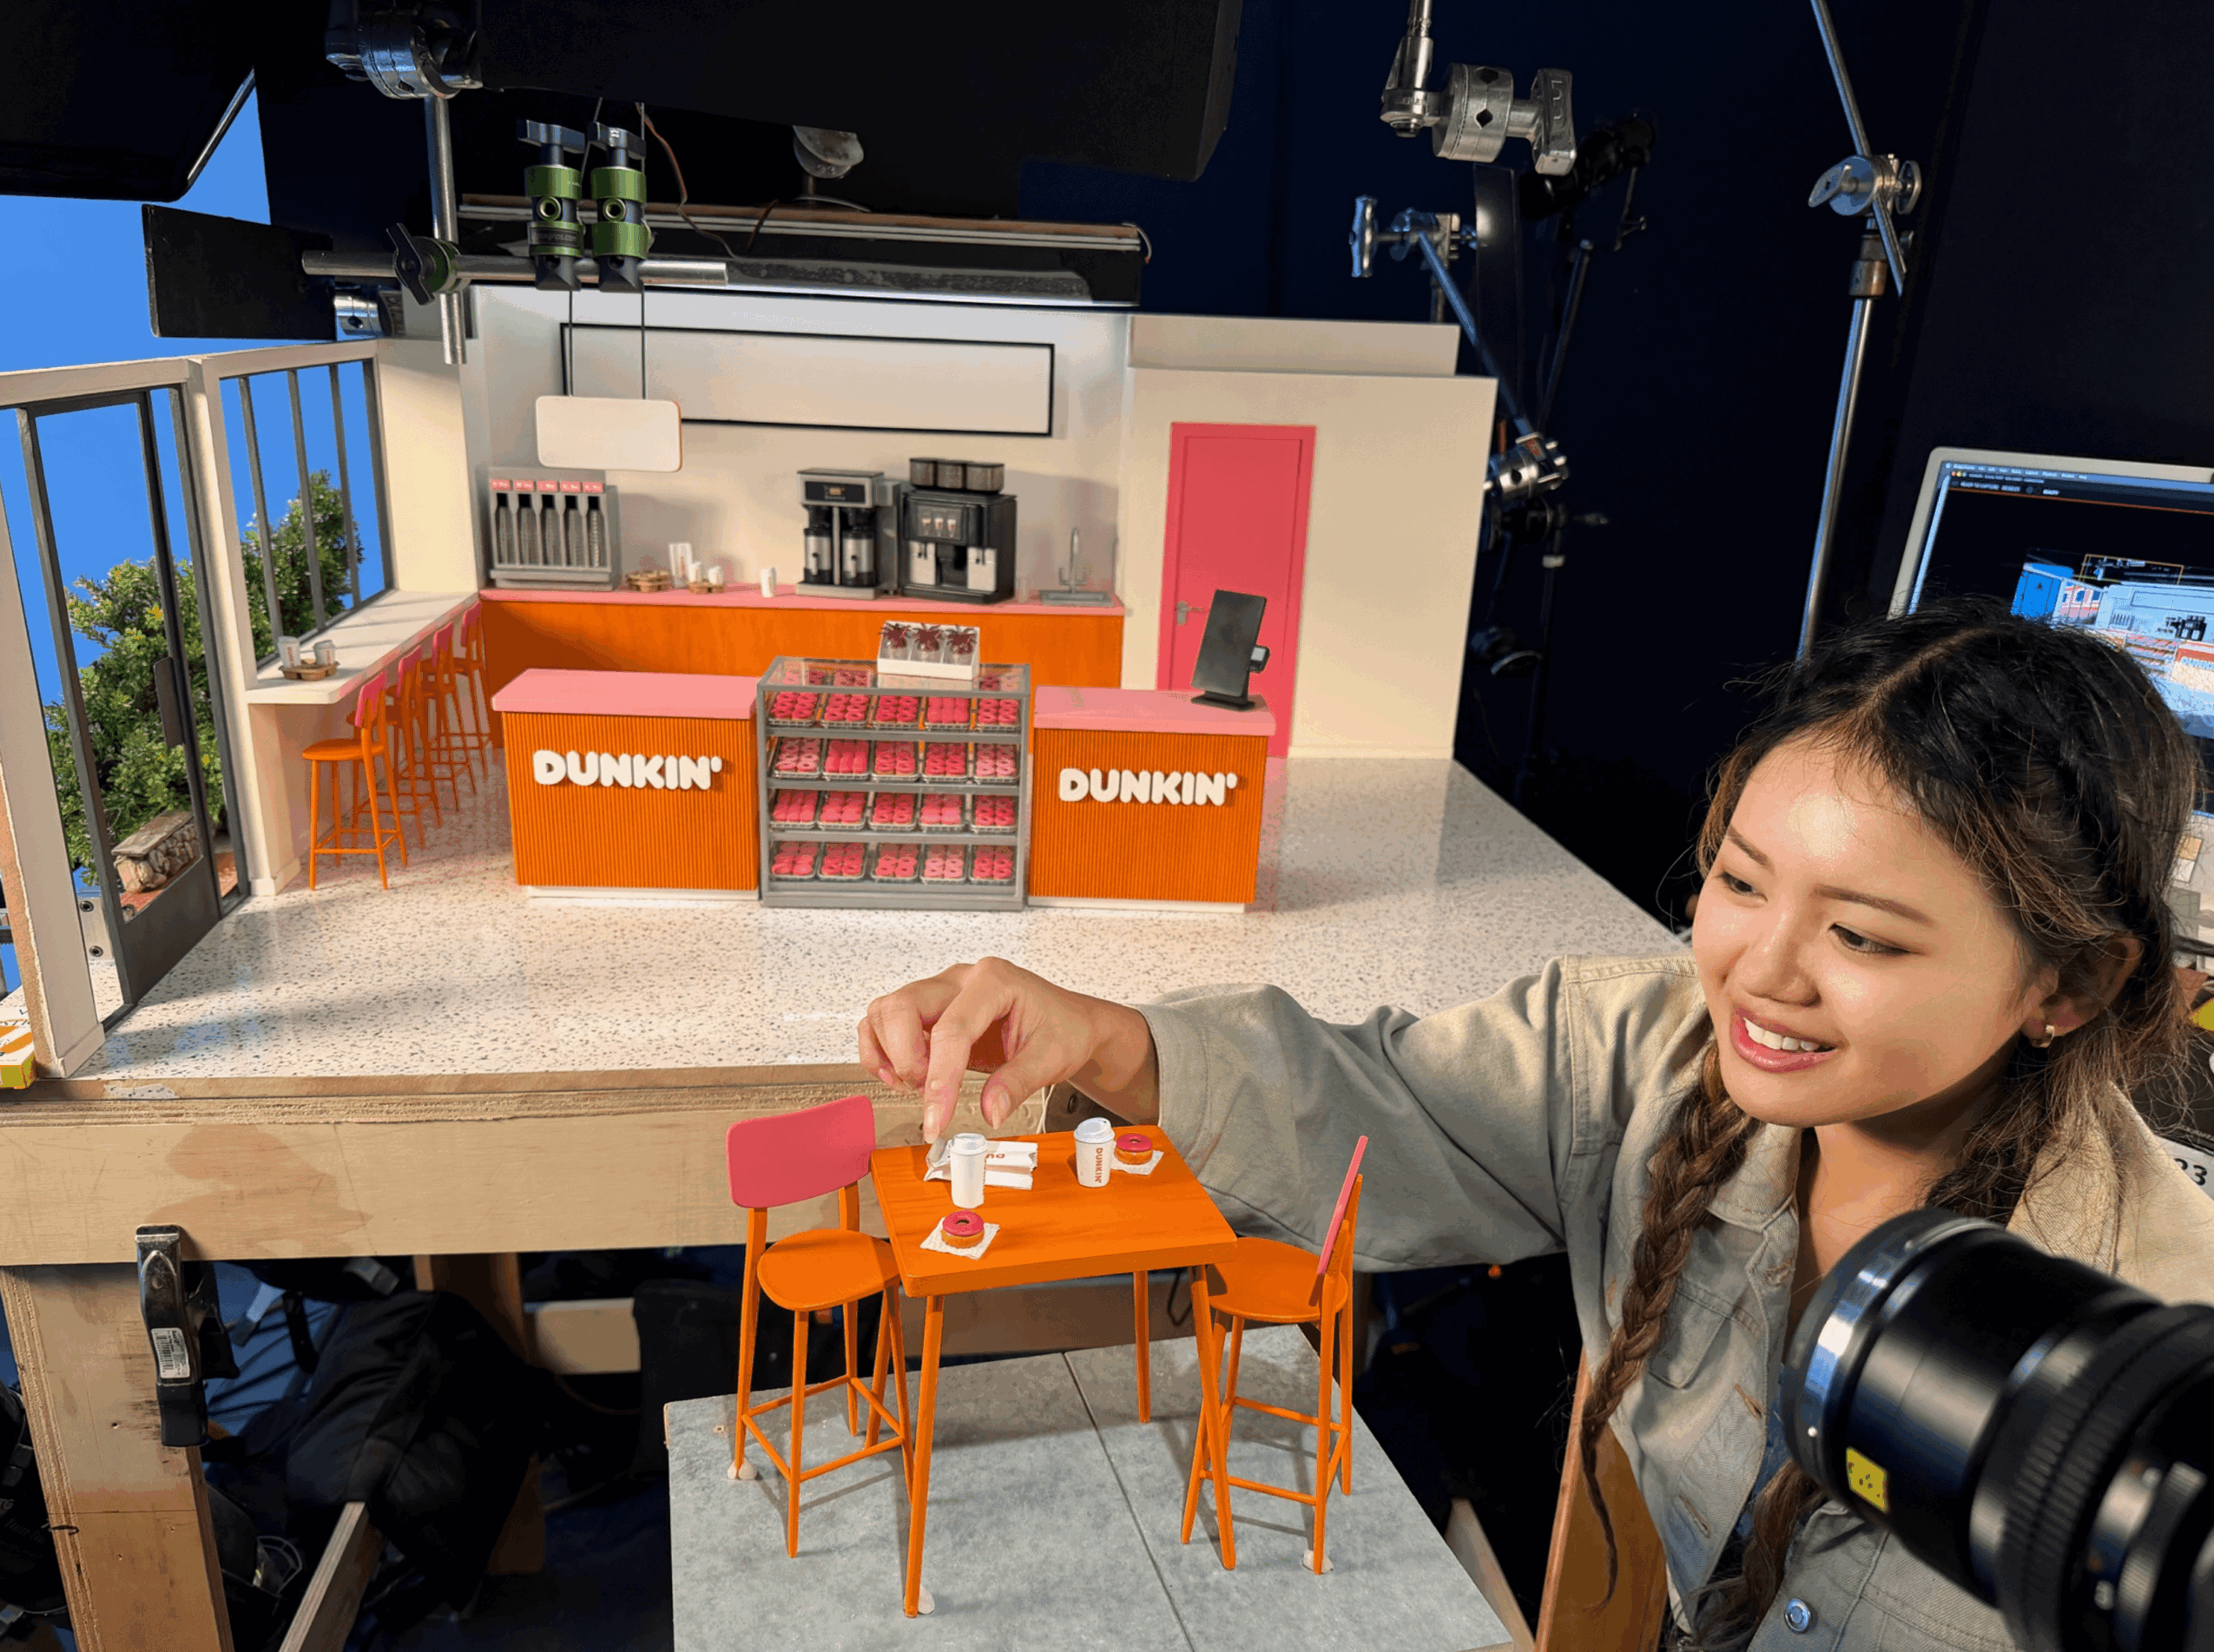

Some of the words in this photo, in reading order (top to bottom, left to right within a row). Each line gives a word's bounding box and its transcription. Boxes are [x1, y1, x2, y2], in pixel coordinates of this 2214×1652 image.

[533, 749, 722, 790] DUNKIN'
[1059, 767, 1238, 806] DUNKIN'
[1094, 1147, 1104, 1183] DUNKIN'
